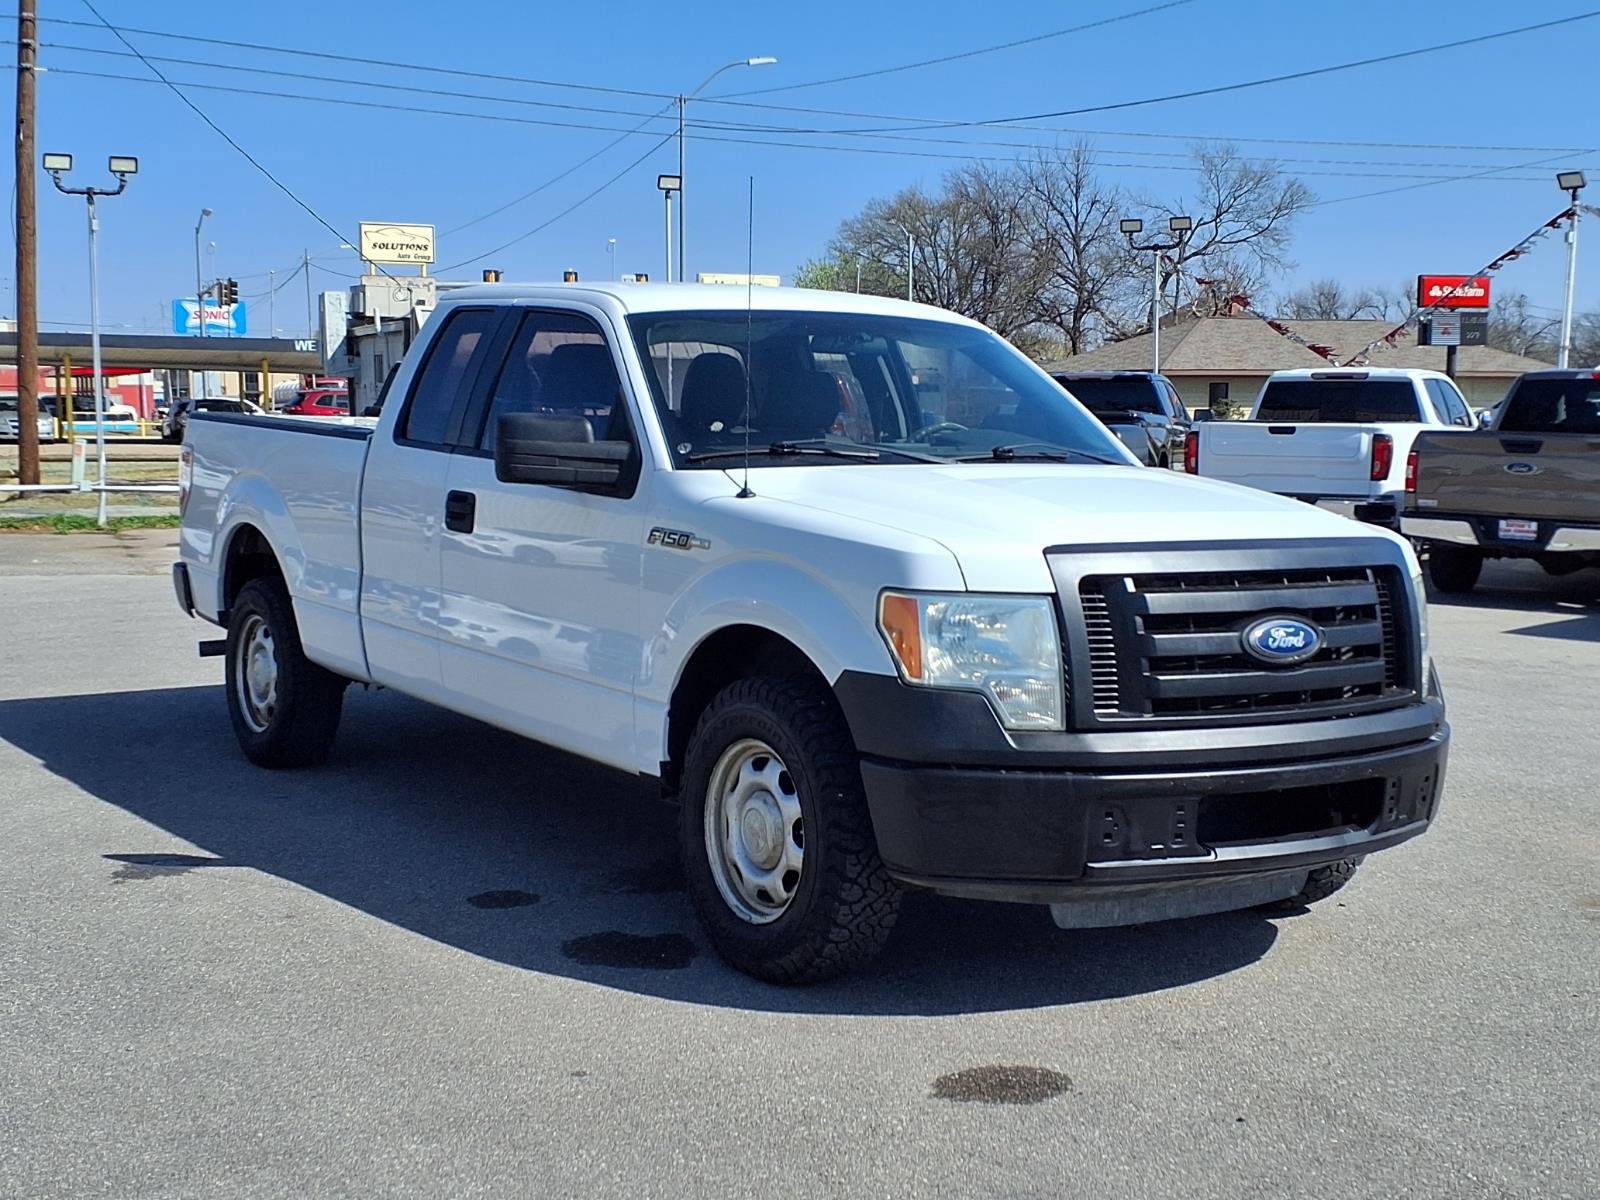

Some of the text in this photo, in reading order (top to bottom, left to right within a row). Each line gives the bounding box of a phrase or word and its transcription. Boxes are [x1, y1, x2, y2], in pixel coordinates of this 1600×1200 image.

[372, 242, 429, 251] SOLUTIONS
[414, 253, 431, 261] Group
[294, 340, 317, 351] WE
[1268, 627, 1306, 649] Ford
